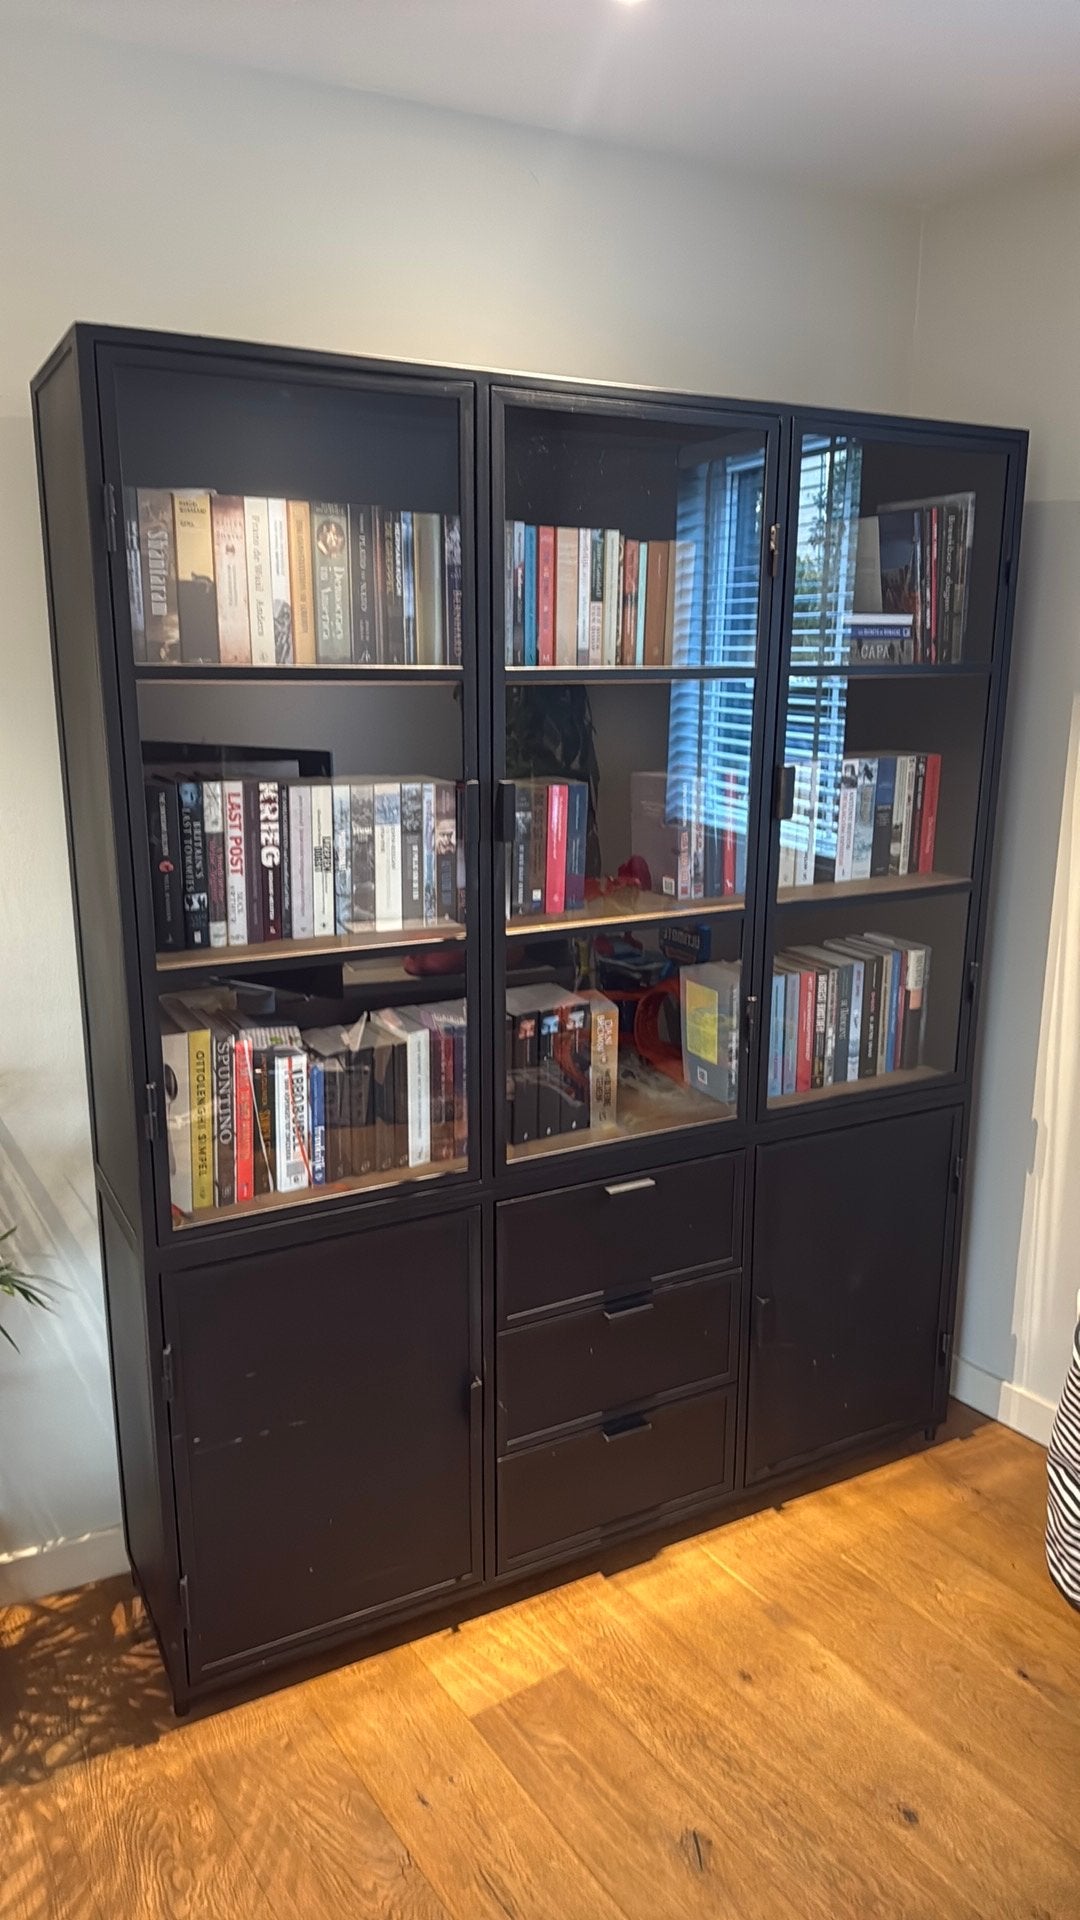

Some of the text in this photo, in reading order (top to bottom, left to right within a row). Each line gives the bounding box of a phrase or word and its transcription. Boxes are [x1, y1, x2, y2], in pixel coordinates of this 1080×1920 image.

[147, 530, 169, 616] Shantaram
[252, 549, 261, 562] de
[860, 644, 890, 660] CAPA
[181, 808, 195, 892] LAST TOMMIES
[193, 821, 204, 879] BRITAIN'S
[227, 792, 244, 877] LAST POST
[259, 781, 281, 869] KRIEG
[596, 1015, 606, 1052] BROWN
[604, 1019, 613, 1046] DAN
[195, 1050, 209, 1177] OTTOLENGHI SIMPEL
[216, 1041, 233, 1145] SPUNTINO
